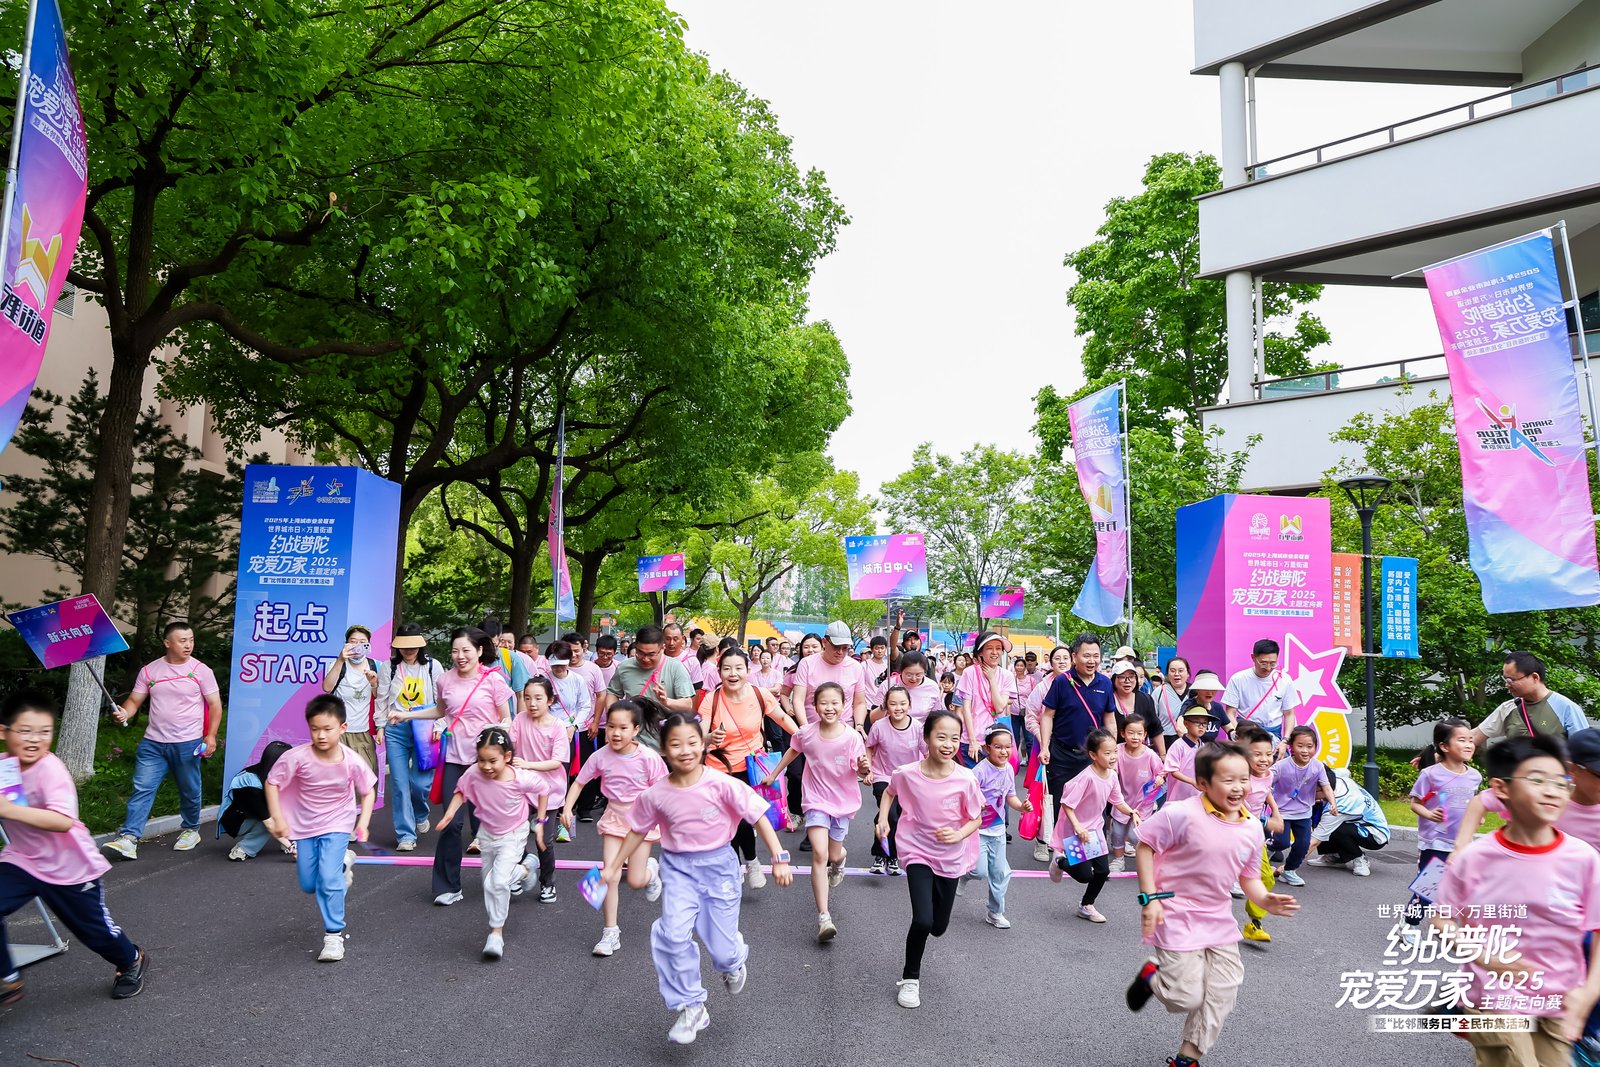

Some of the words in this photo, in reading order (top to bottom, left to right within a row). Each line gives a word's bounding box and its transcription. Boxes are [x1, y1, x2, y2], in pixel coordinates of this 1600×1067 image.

[268, 534, 329, 554] 约战普陀
[247, 555, 308, 575] 宠爱万家
[310, 557, 338, 566] 2025
[863, 562, 913, 574] 城市日中心
[1250, 568, 1306, 587] 约战普陀
[1231, 588, 1288, 606] 宠爱万家
[1291, 590, 1316, 599] 2025
[252, 600, 328, 643] 起点
[240, 653, 338, 684] START
